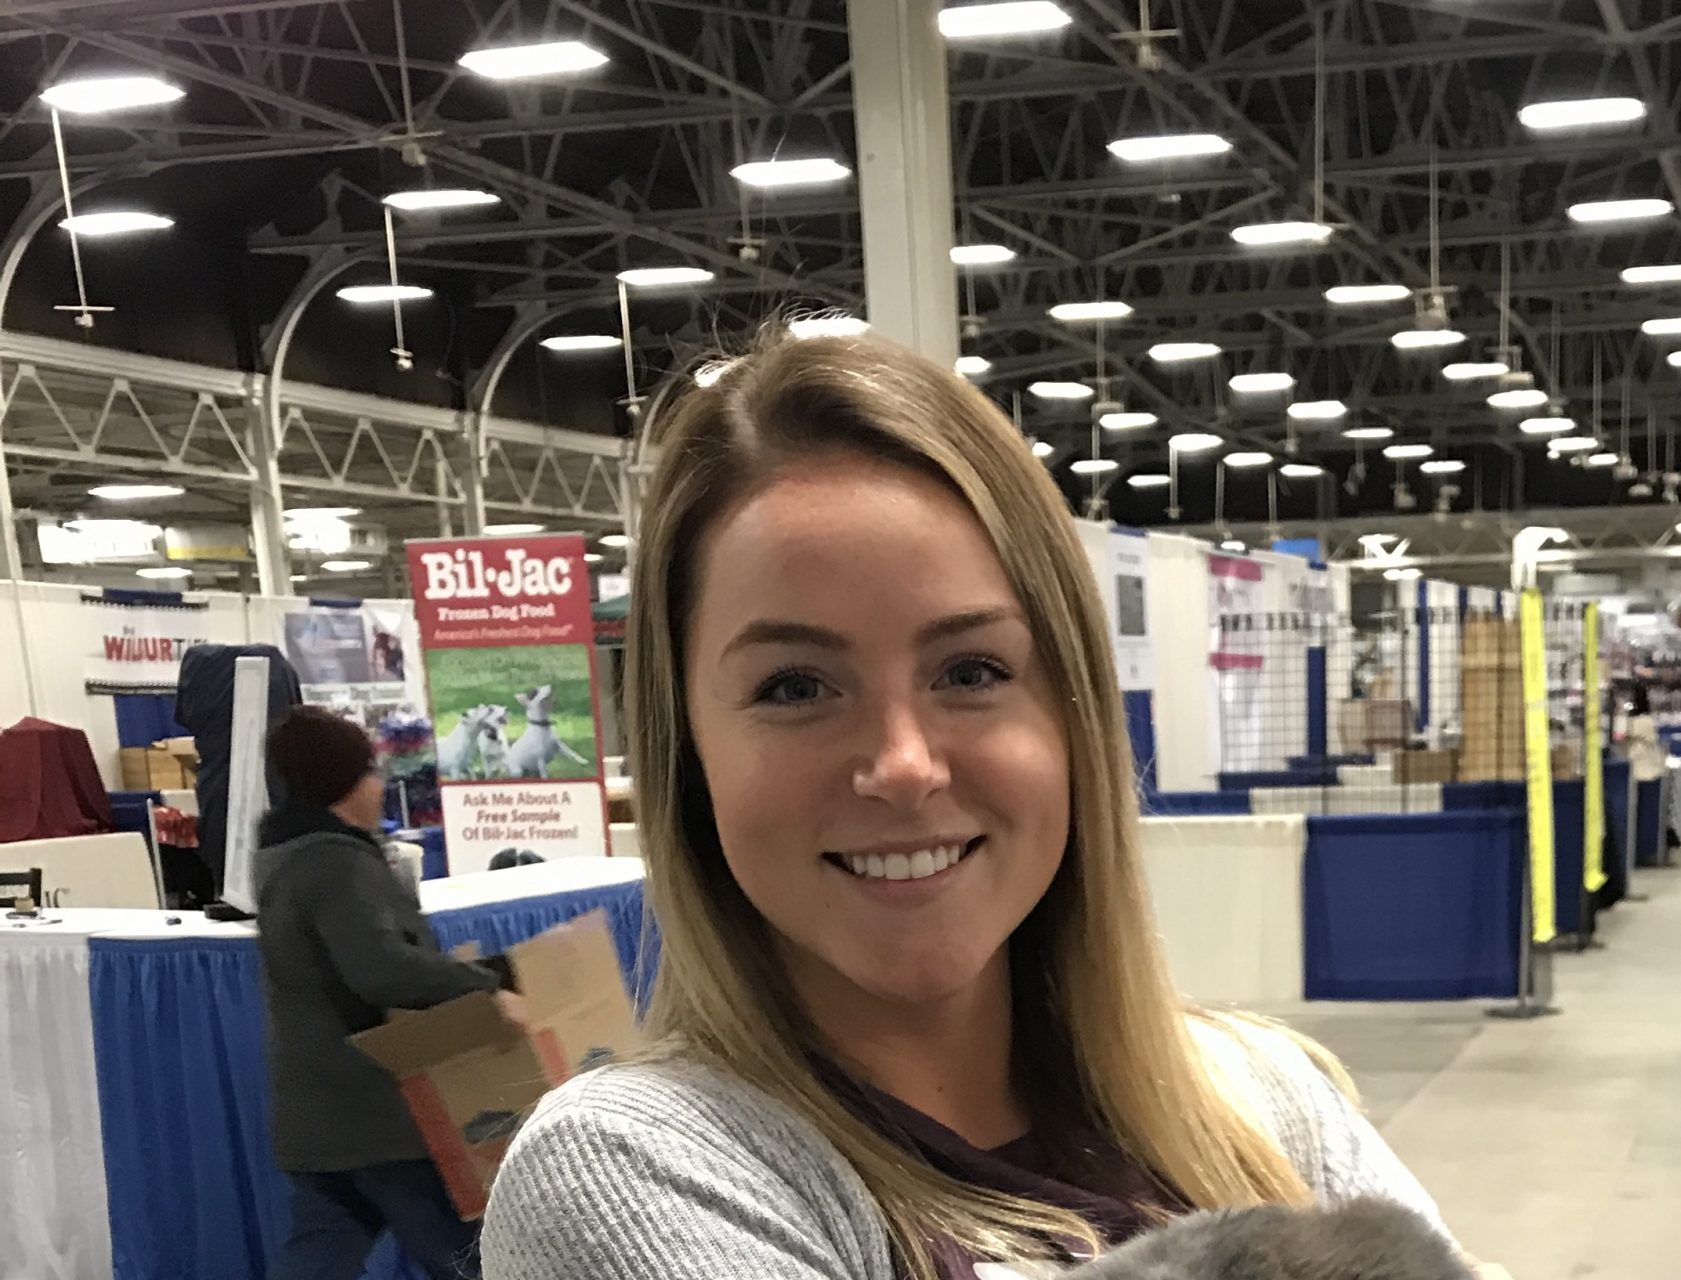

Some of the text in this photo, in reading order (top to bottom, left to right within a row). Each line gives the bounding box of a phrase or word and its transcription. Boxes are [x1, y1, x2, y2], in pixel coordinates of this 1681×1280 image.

[437, 603, 556, 621] Frozen Dog Food
[463, 791, 572, 807] Ask Me About A
[477, 809, 561, 824] Free Sample
[462, 827, 479, 841] Of
